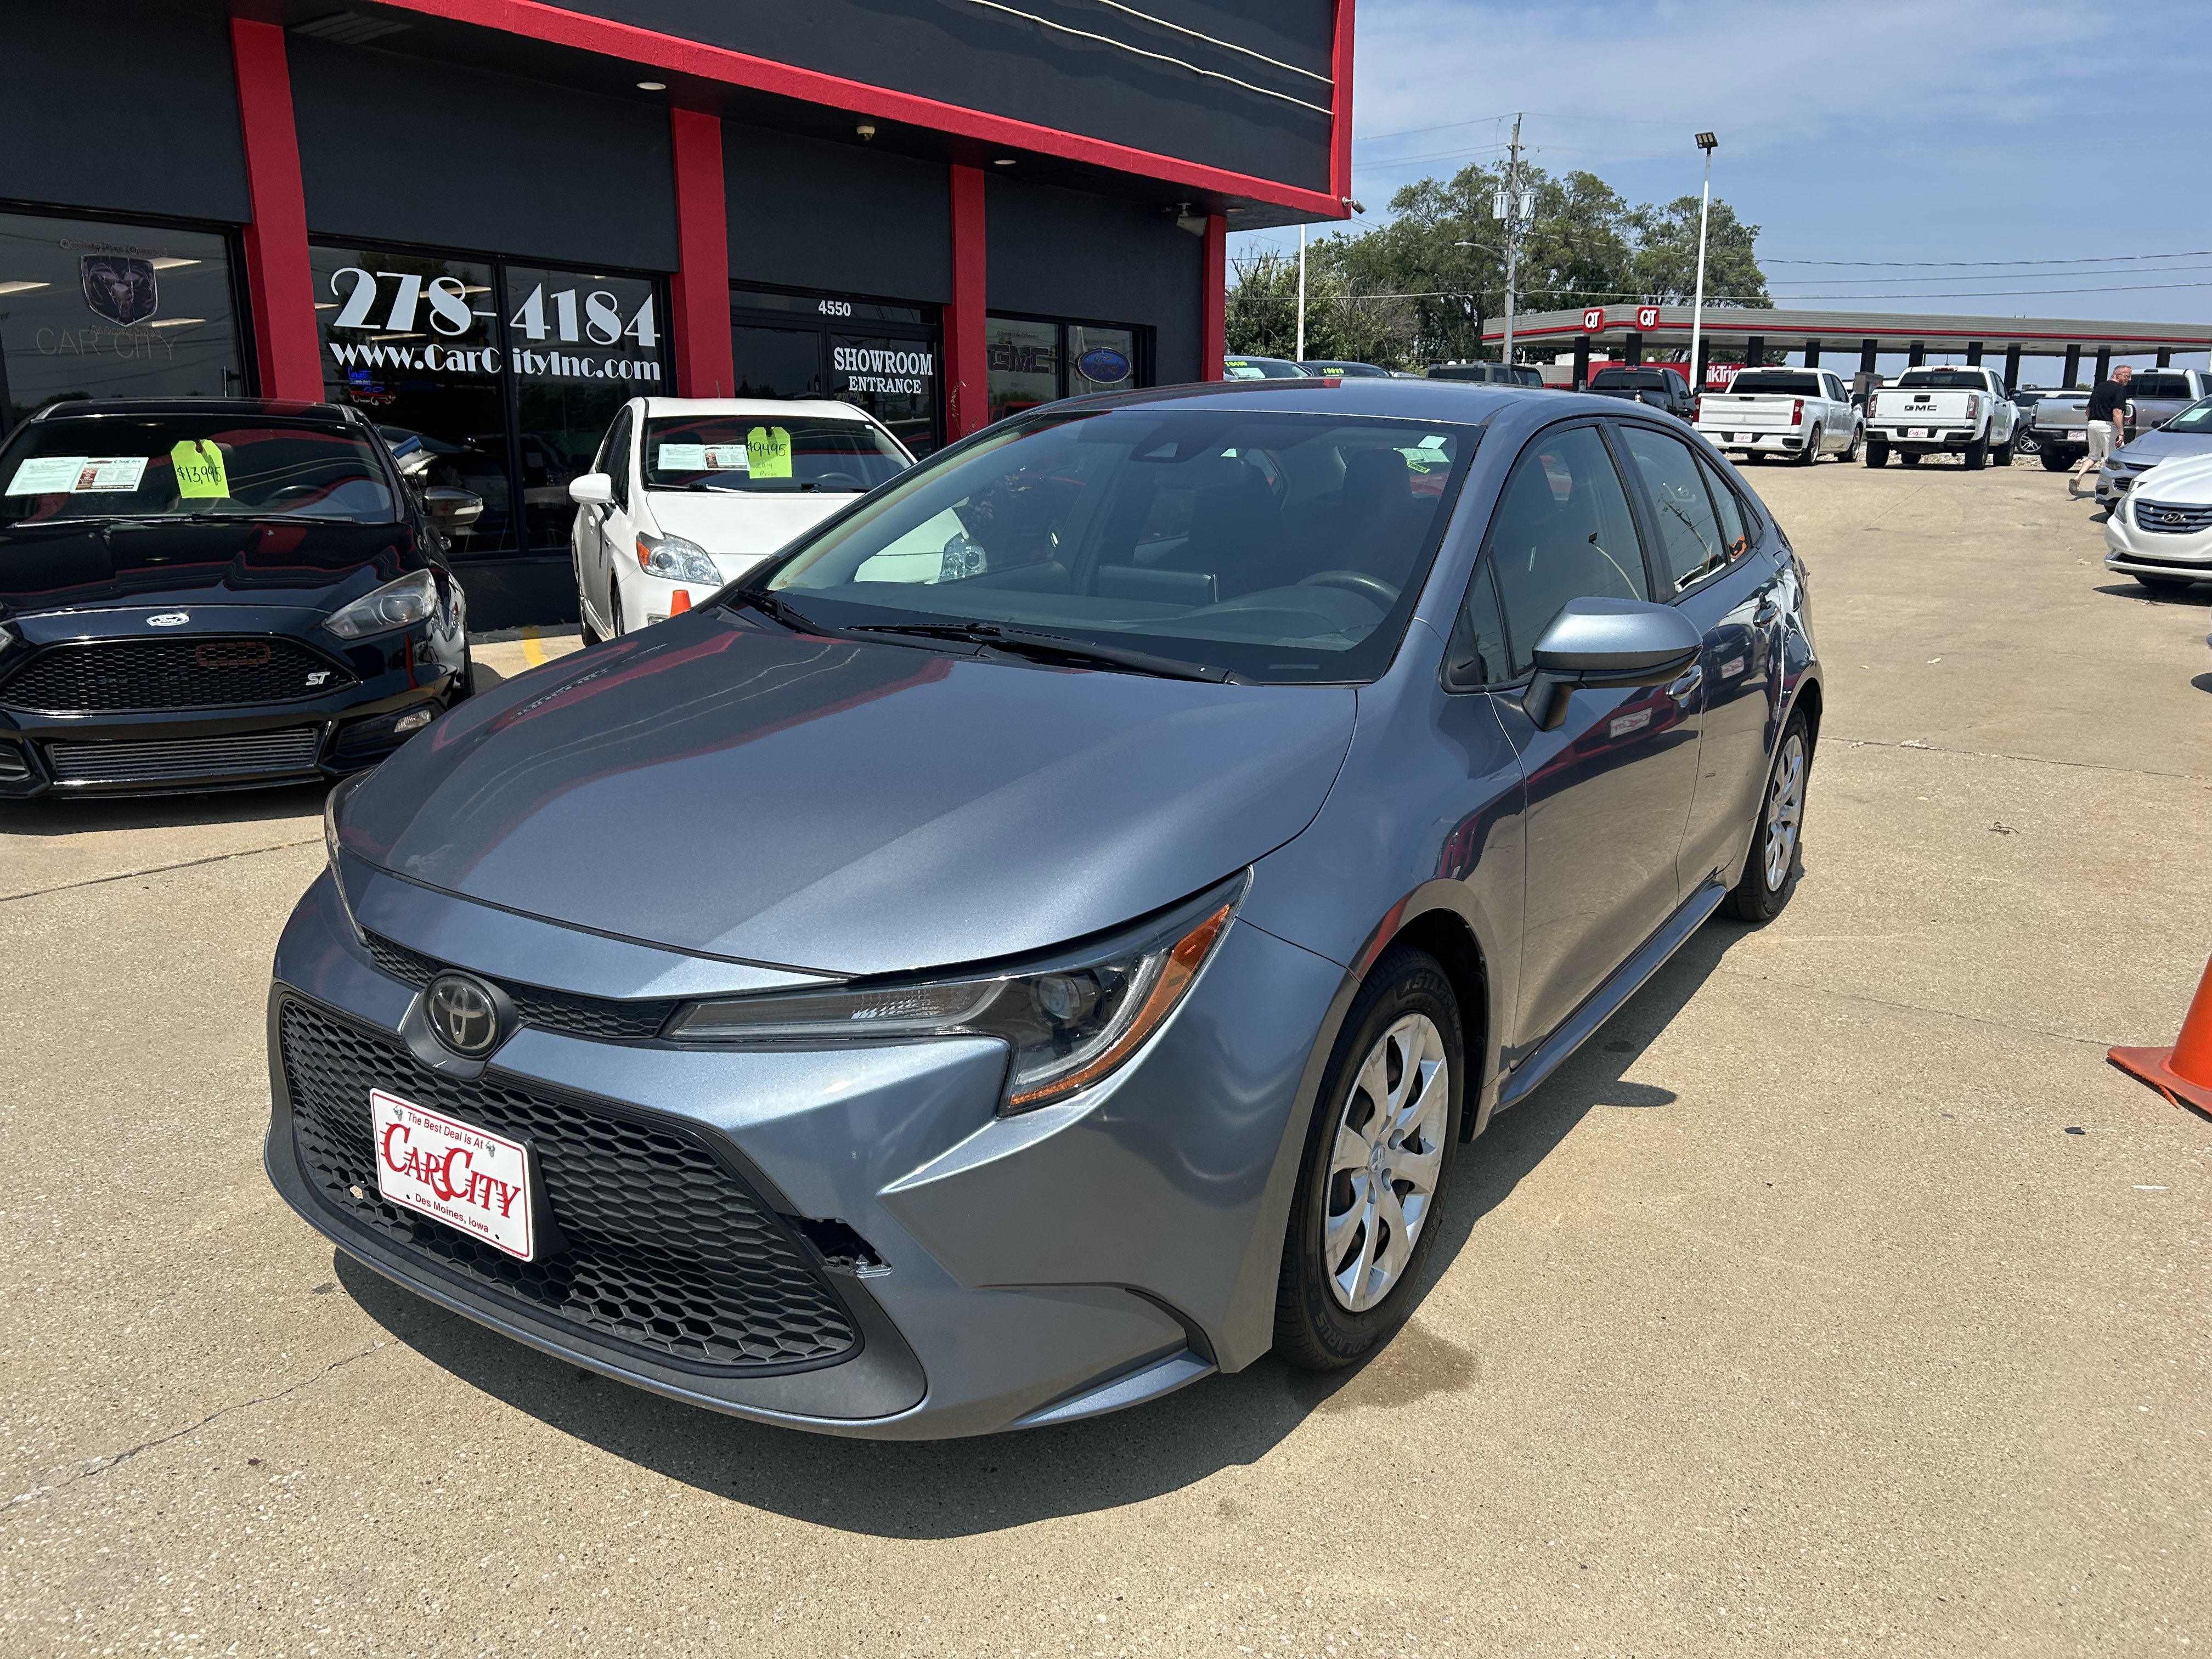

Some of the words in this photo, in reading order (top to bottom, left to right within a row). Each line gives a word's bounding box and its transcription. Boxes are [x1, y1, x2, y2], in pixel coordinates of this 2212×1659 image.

[819, 300, 851, 317] 4550
[1640, 309, 1656, 326] QT
[1585, 312, 1599, 329] QT
[36, 328, 101, 356] CAR
[834, 347, 933, 375] SHOWROOM
[989, 343, 1050, 374] GMC
[849, 376, 922, 394] ENTRANCE
[177, 465, 222, 485] $13,995
[306, 672, 330, 686] ST
[408, 1111, 422, 1126] The
[424, 1119, 442, 1133] Best
[444, 1126, 462, 1142] Deal
[465, 1133, 472, 1144] Is
[474, 1138, 483, 1149] At
[415, 1193, 431, 1207] Des
[433, 1201, 466, 1224] Moines,
[469, 1216, 489, 1233] Iowa
